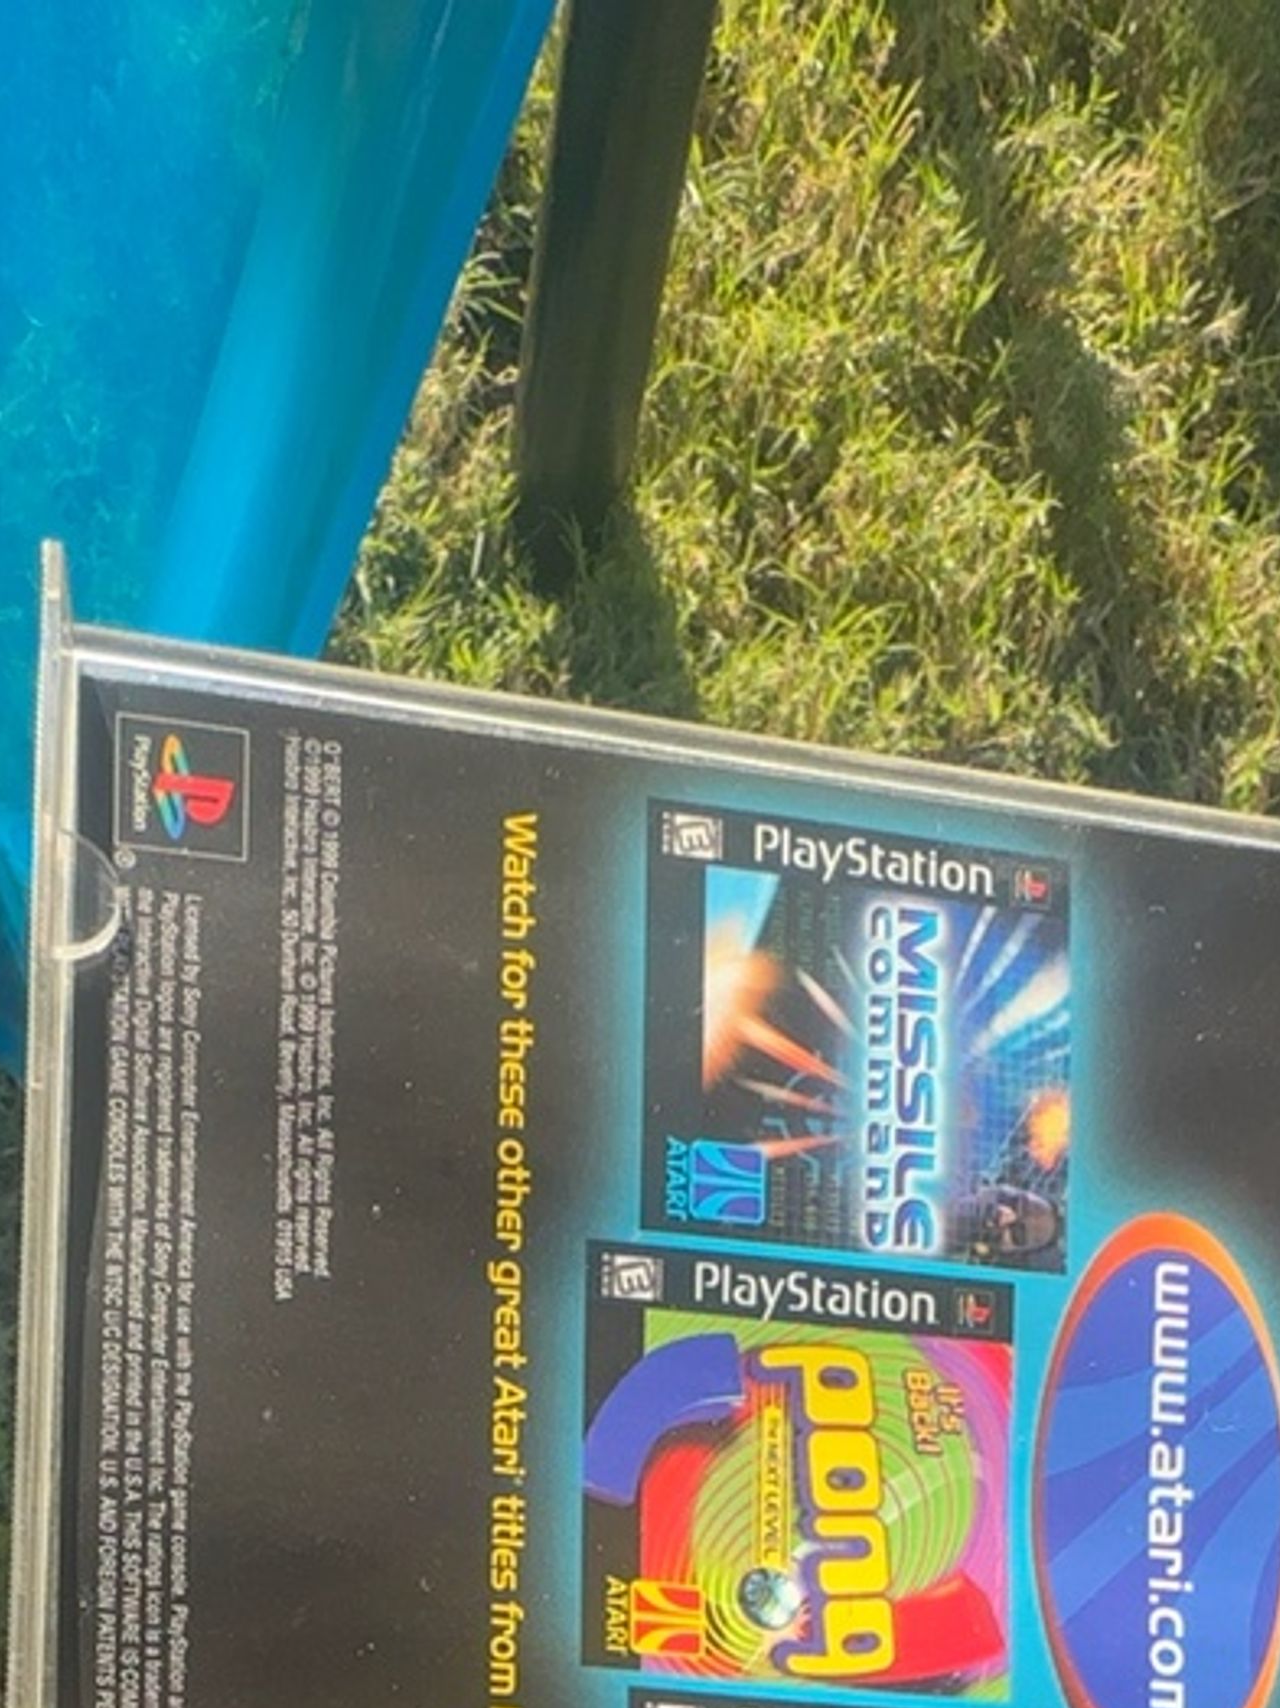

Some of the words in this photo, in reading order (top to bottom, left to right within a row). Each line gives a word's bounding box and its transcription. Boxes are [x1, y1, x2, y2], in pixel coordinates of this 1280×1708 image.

[130, 734, 150, 832] PlayStation
[501, 814, 537, 939] Watch
[754, 824, 996, 898] PlayStation
[500, 949, 535, 1009] for
[497, 1018, 533, 1127] these
[894, 907, 939, 1251] MISSILE
[495, 1138, 529, 1250] other
[665, 1136, 686, 1222] ATARI
[487, 1261, 526, 1367] great
[694, 1262, 940, 1325] PlayStation
[903, 1369, 942, 1456] Back!
[935, 1384, 965, 1434] It's
[765, 1441, 779, 1488] NEXT
[490, 1494, 525, 1590] titles
[758, 1345, 896, 1676] pong
[763, 1493, 779, 1562] LEVEL
[489, 1601, 523, 1695] from
[604, 1576, 627, 1653] ATARI
